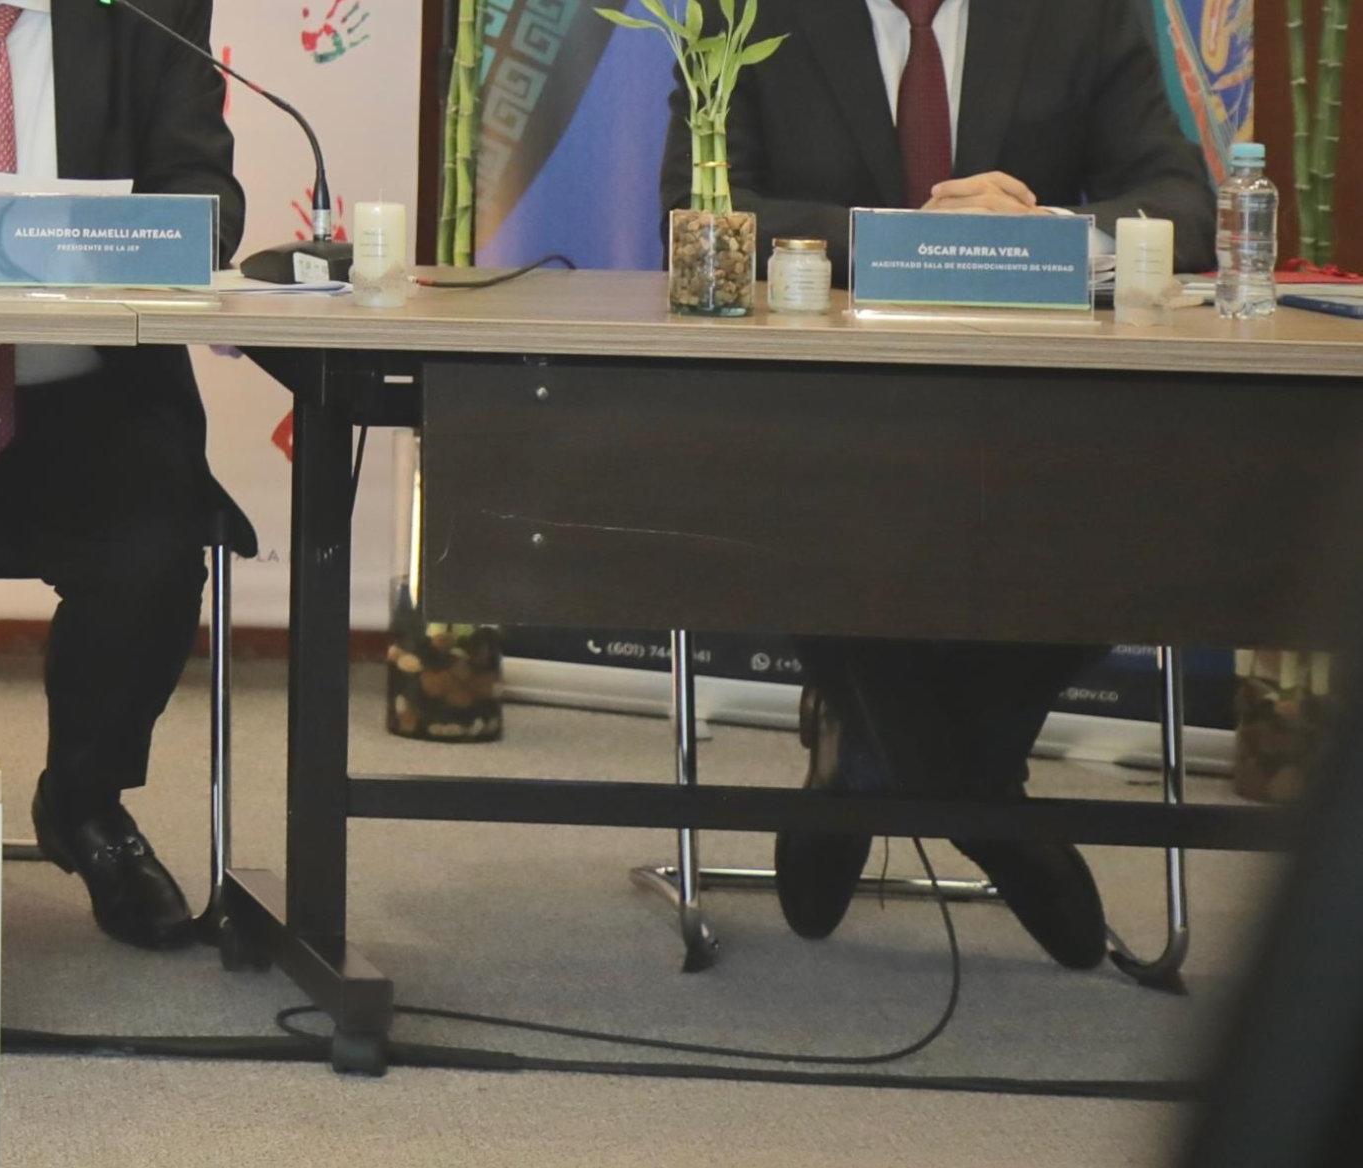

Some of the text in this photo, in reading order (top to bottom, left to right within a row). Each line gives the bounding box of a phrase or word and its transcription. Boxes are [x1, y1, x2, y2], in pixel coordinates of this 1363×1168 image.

[14, 228, 182, 239] ALEJANDRO RAMELLI ARTEAGA
[918, 243, 1030, 257] ÓSCAR PARRA VERA
